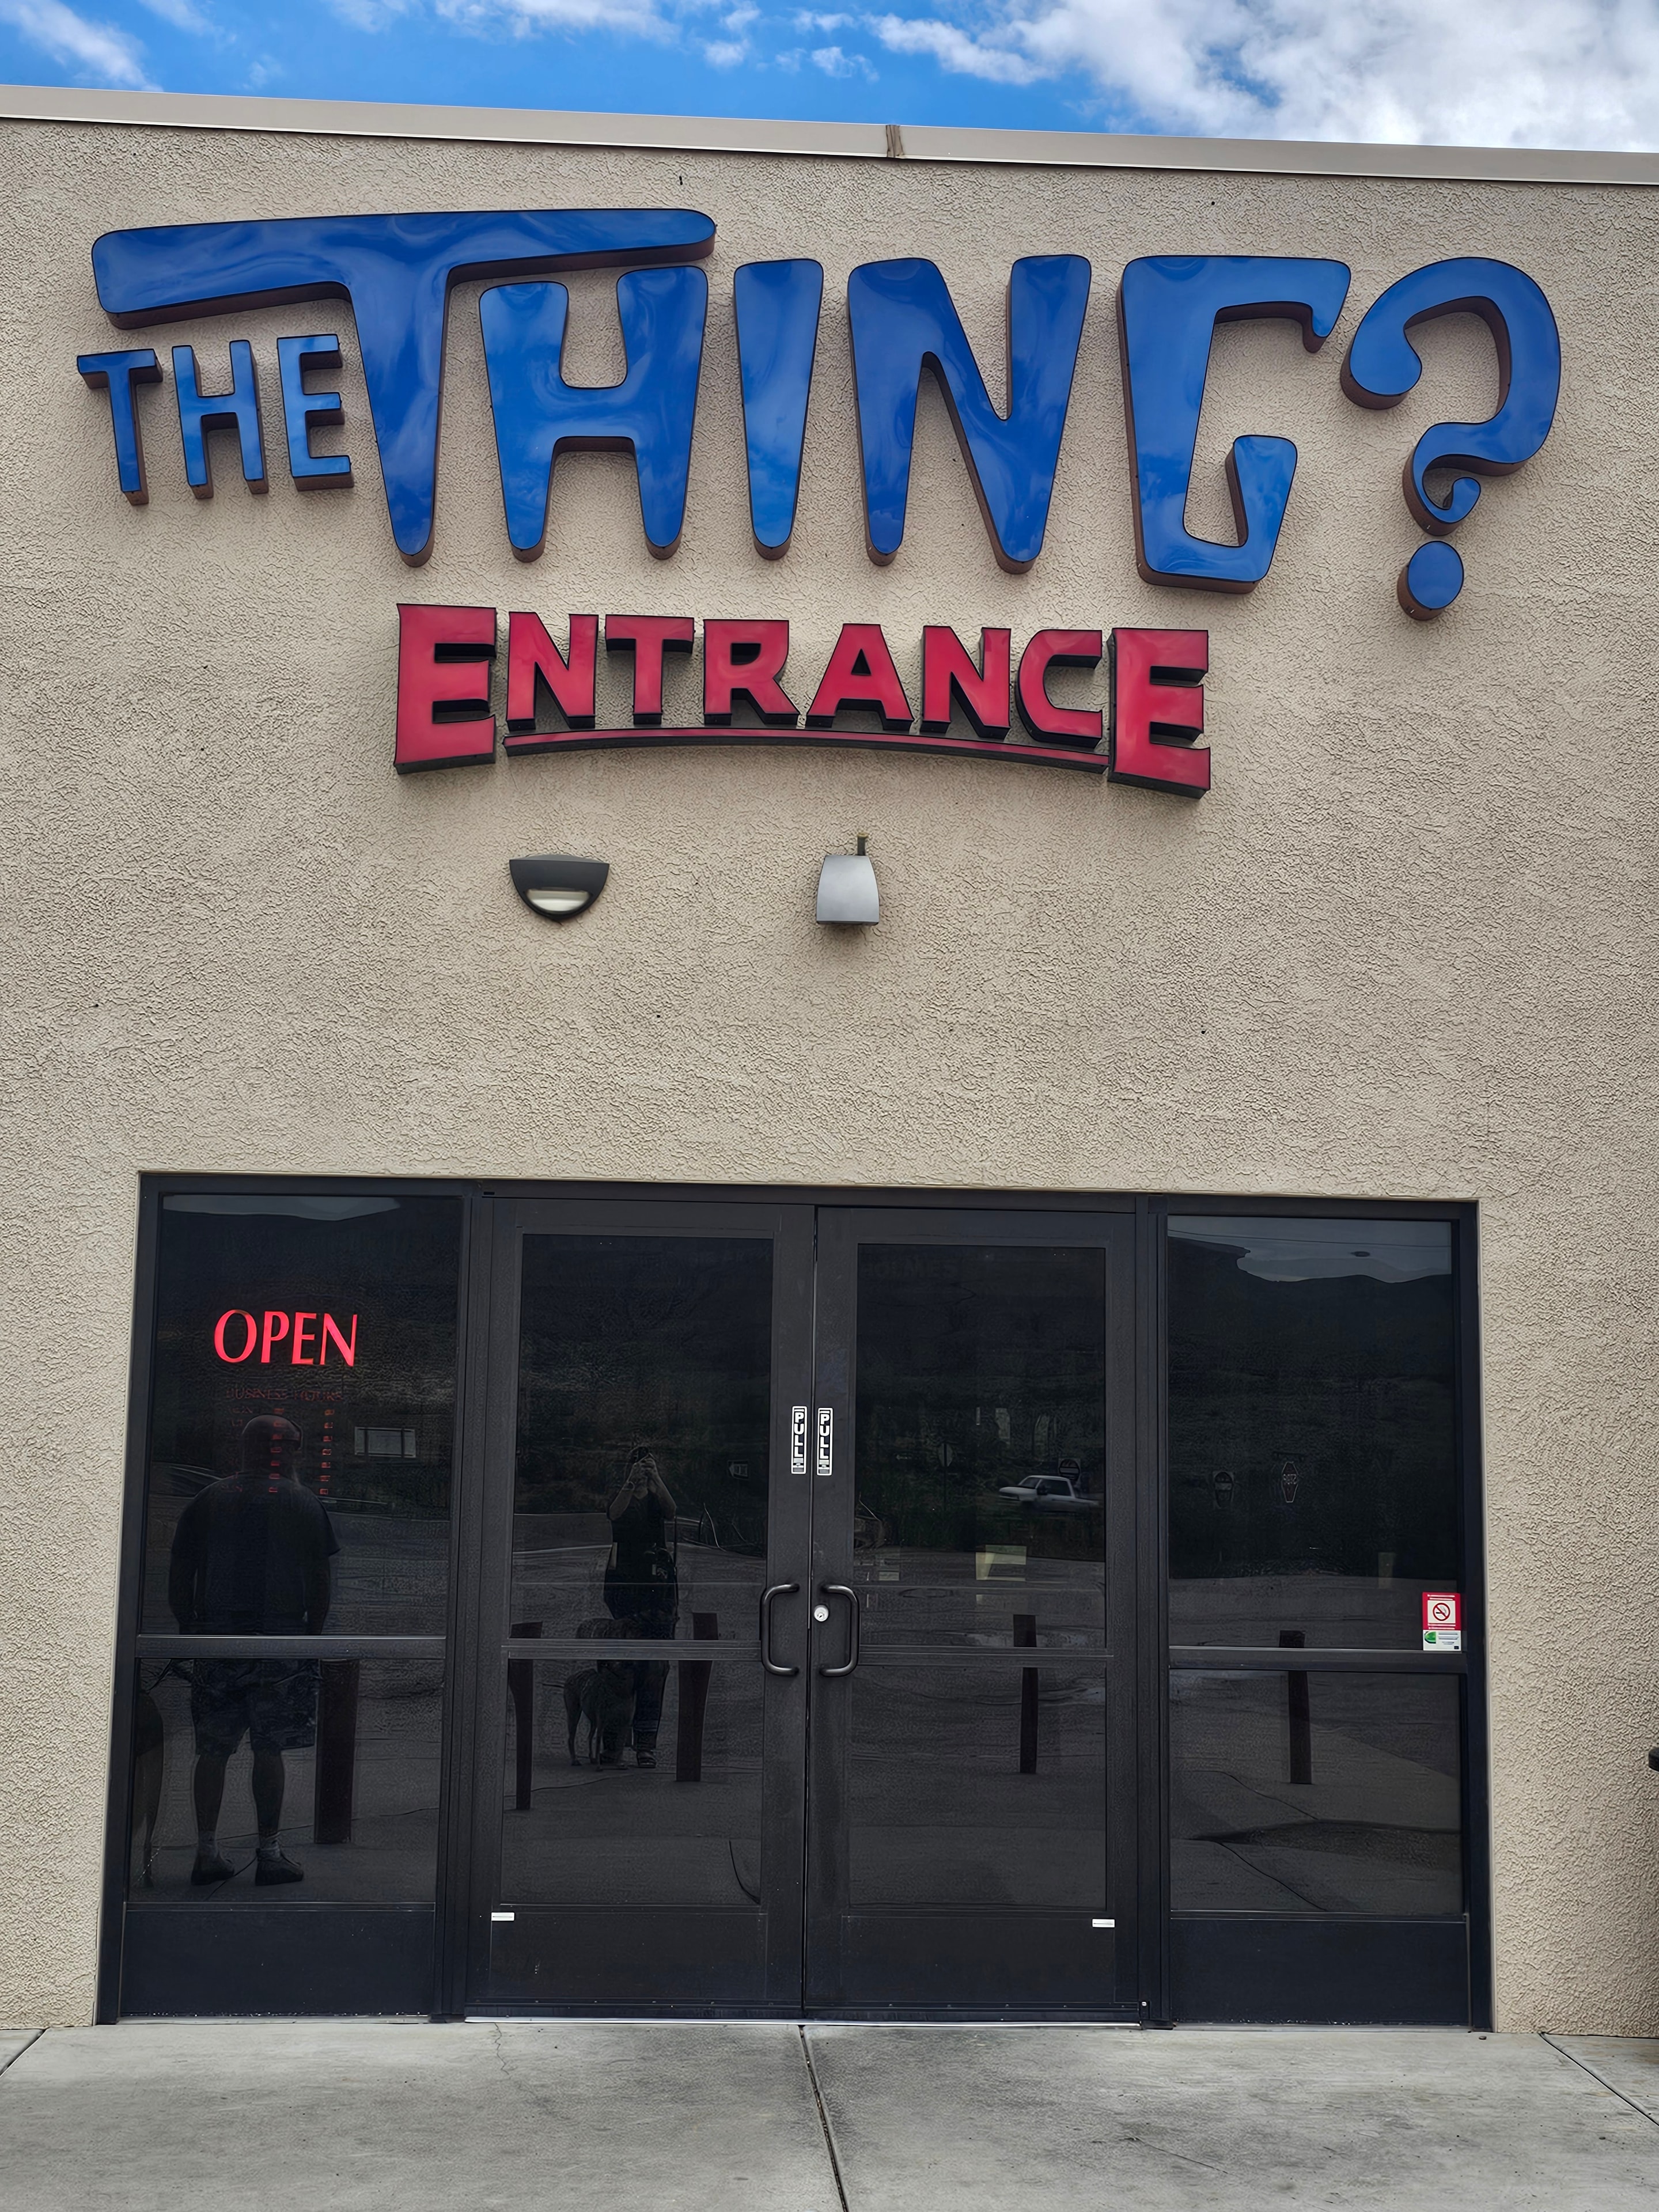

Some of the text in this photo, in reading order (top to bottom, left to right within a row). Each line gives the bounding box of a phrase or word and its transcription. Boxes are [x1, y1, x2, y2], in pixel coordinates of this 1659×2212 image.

[77, 209, 1561, 620] THE THING?
[395, 603, 1211, 798] ENTRANCE
[214, 1309, 357, 1366] OPEN
[794, 1412, 804, 1457] PULL
[819, 1414, 830, 1459] PULL
